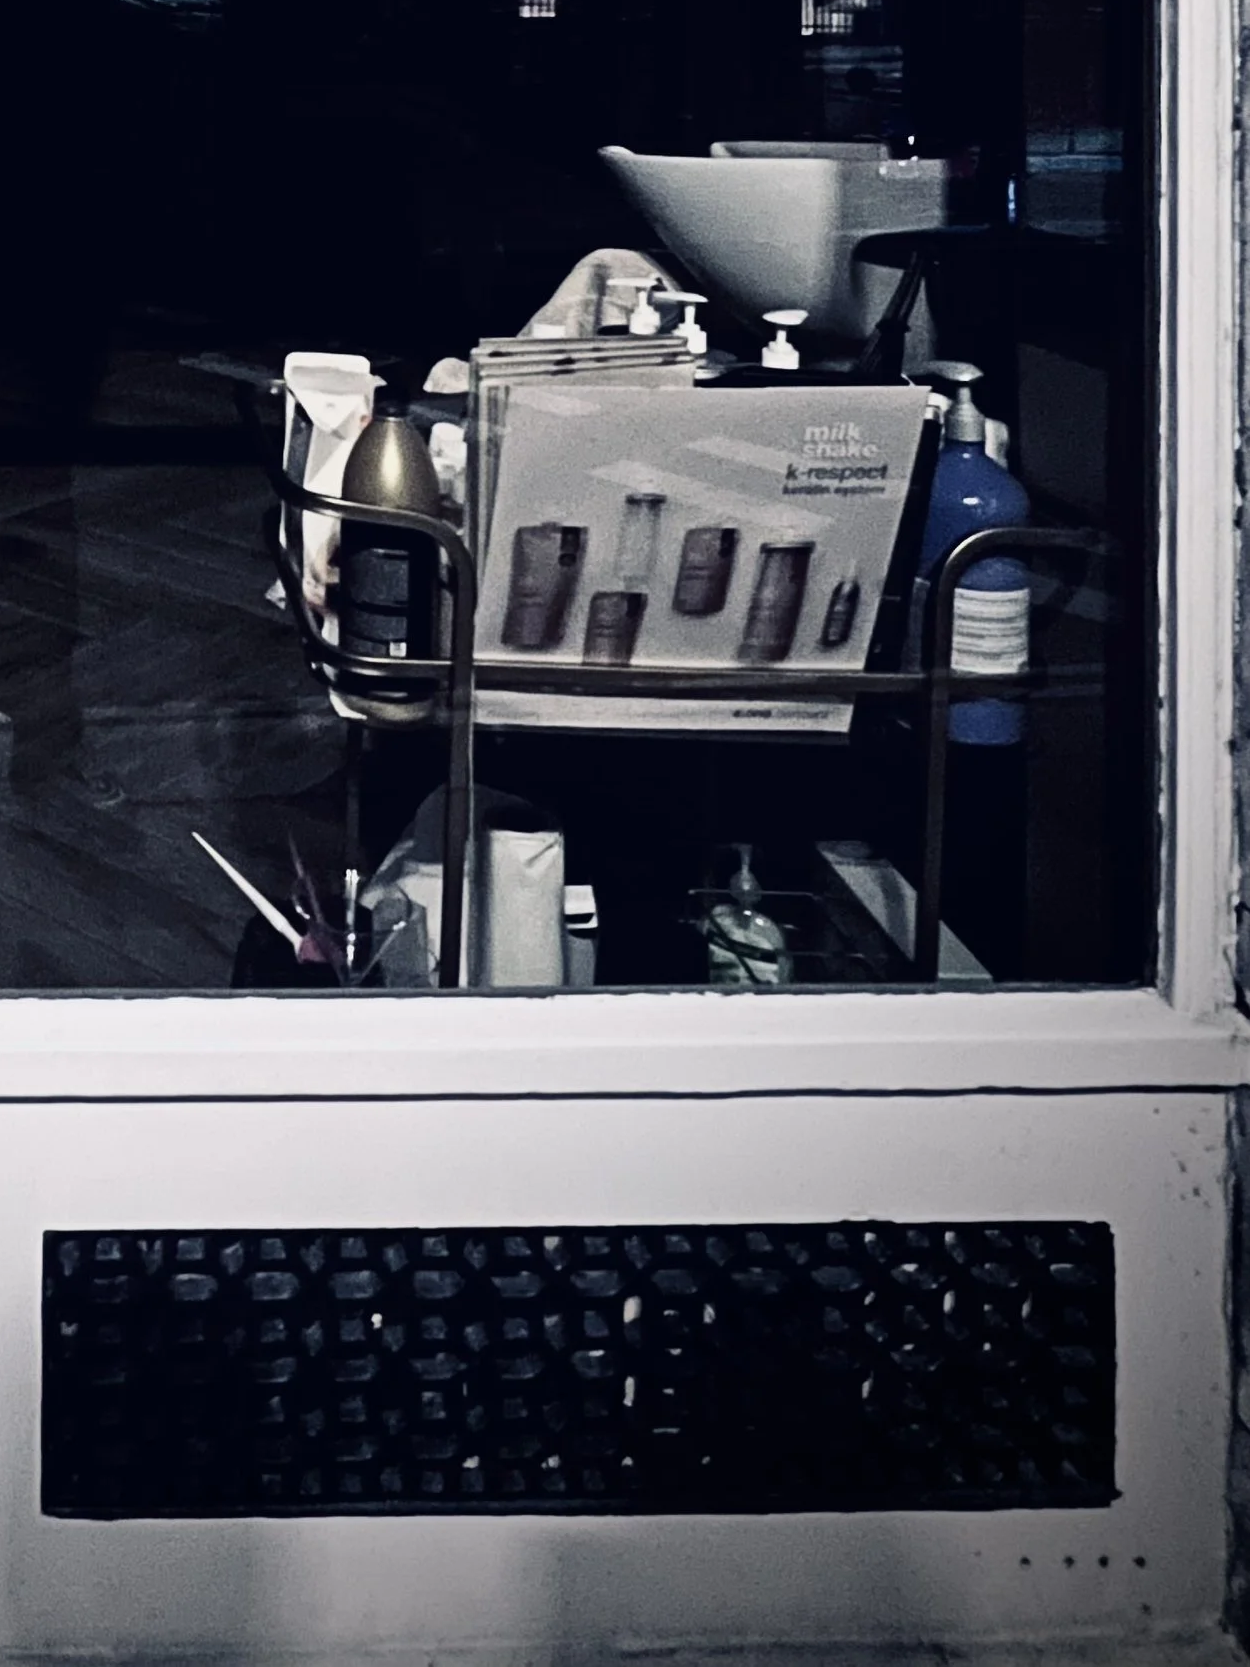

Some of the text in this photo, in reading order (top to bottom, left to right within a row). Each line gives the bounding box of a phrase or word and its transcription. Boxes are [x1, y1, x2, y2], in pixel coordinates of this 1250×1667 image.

[803, 421, 862, 441] milk
[802, 441, 880, 458] shake
[785, 463, 888, 483] k-respect
